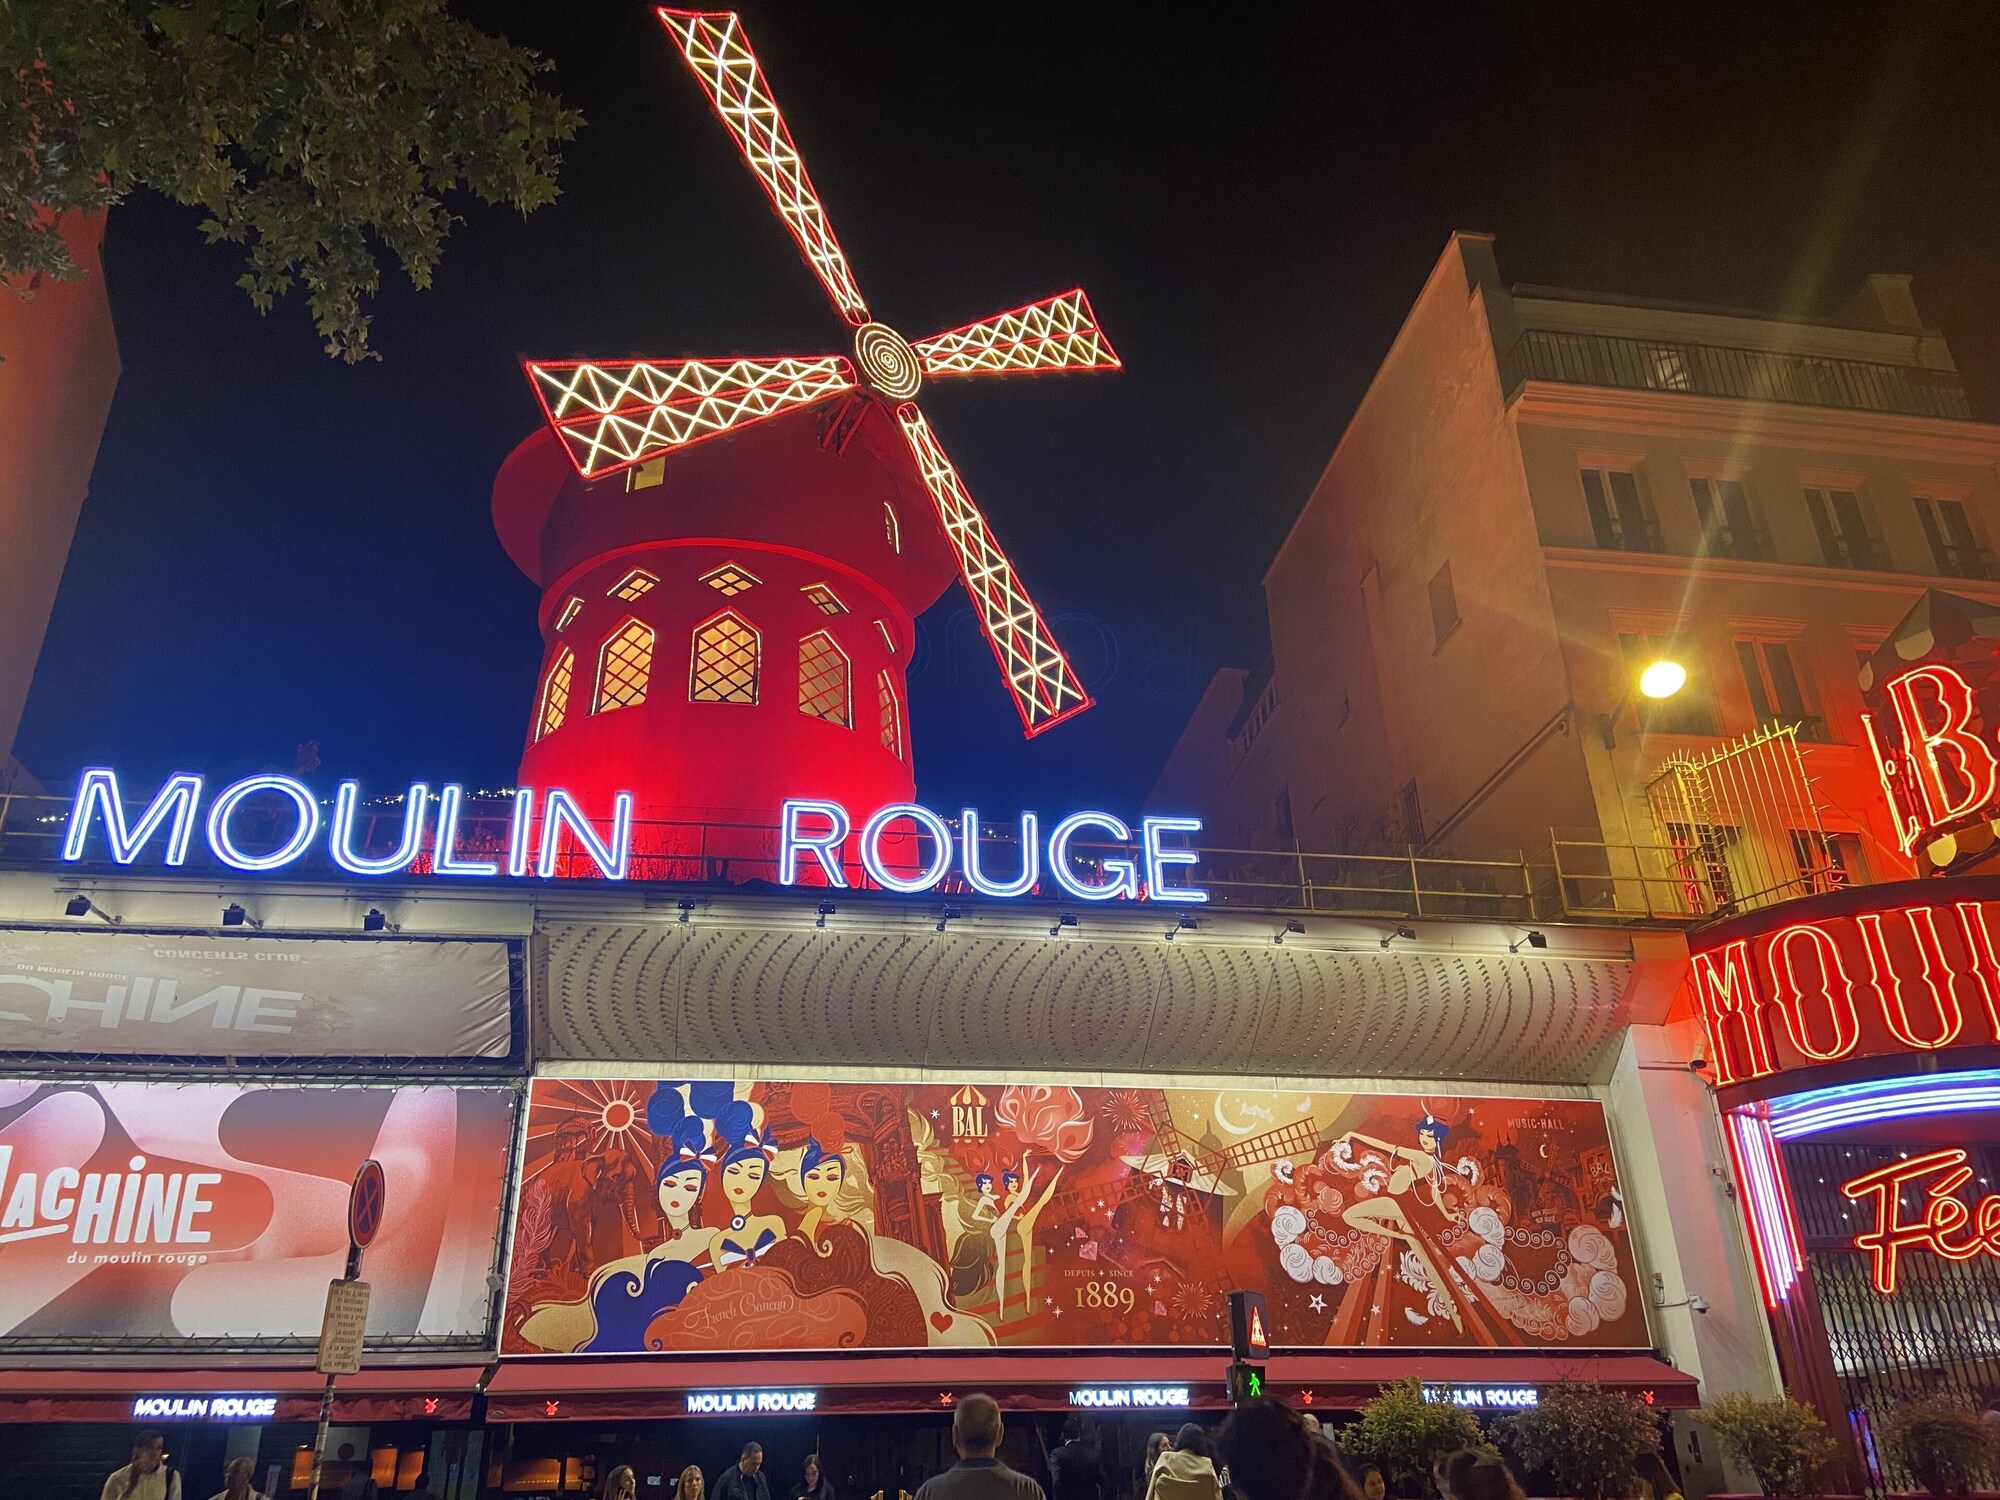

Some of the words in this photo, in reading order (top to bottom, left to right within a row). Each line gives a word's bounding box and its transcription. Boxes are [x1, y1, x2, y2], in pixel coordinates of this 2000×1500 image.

[1887, 665, 2000, 827] B
[62, 767, 632, 880] MOULIN
[780, 797, 1210, 902] ROUGE
[951, 1106, 988, 1137] BAL
[1507, 1118, 1565, 1130] MUSIC-HALL
[67, 1251, 88, 1264] du
[94, 1251, 151, 1264] moulin
[157, 1253, 208, 1266] rouge
[1064, 1269, 1095, 1277] DEPUIS
[1109, 1269, 1134, 1277] SINCE
[1074, 1281, 1135, 1315] 1889
[682, 1302, 737, 1333] French
[739, 1292, 794, 1317] Cancan
[133, 1398, 208, 1416] MOULIN
[210, 1398, 277, 1416] ROUGE
[687, 1393, 755, 1413] MOULIN
[757, 1392, 816, 1411] ROUGE
[1068, 1389, 1130, 1407] MOULIN
[1132, 1388, 1189, 1406] ROUGE
[1485, 1389, 1538, 1406] ROUGE
